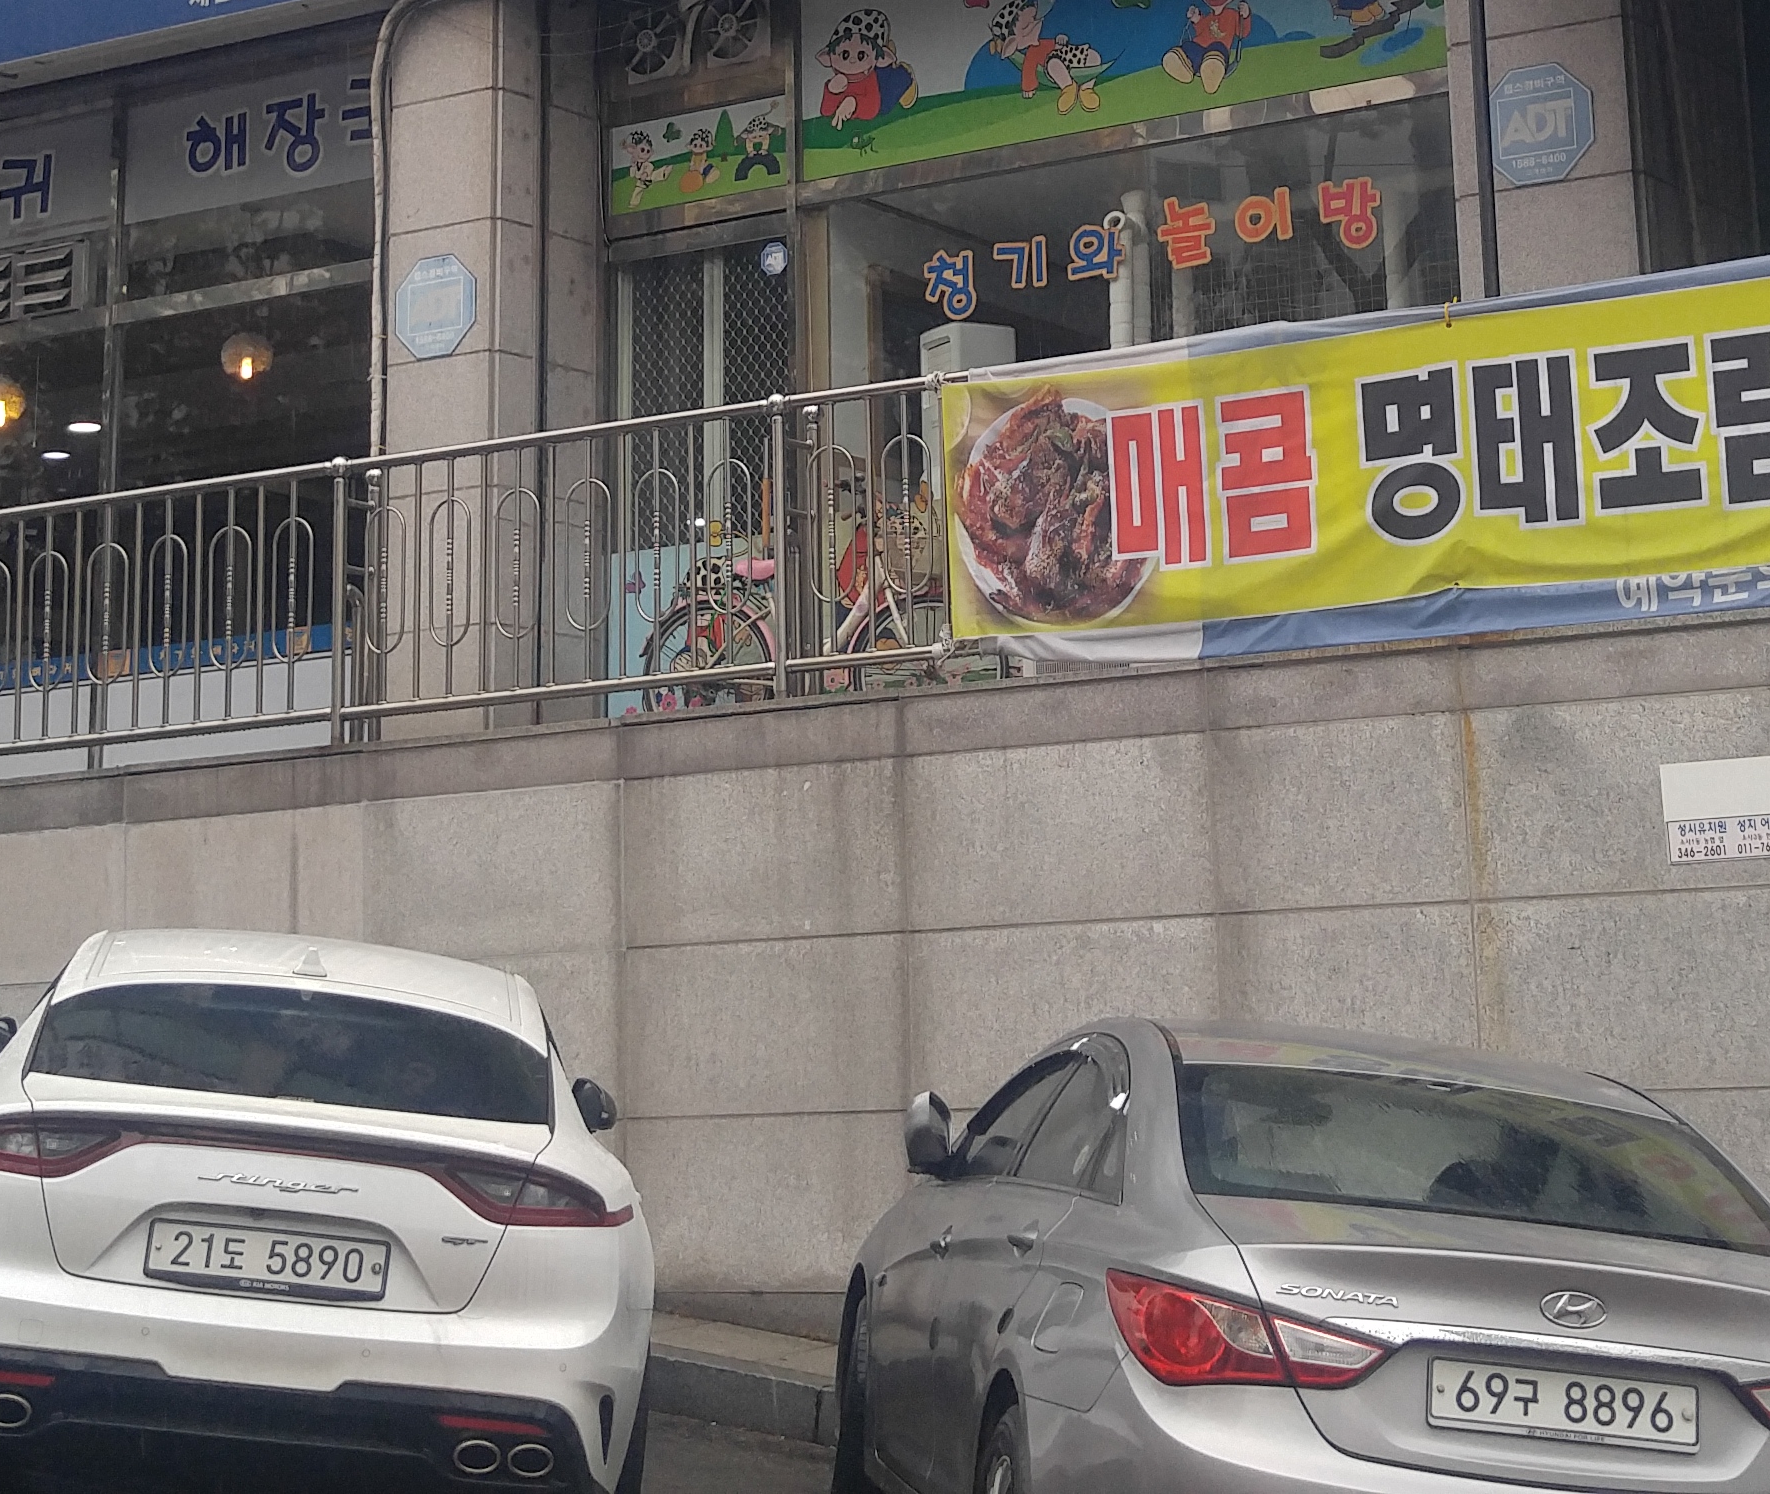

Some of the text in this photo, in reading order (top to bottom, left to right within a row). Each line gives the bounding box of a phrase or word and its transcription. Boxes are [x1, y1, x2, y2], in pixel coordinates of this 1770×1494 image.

[1500, 98, 1574, 148] ADT
[925, 176, 1382, 320] 청기와 놀이방
[1109, 386, 1317, 570] 매콤
[1677, 844, 1727, 859] 346-2601
[265, 1237, 365, 1286] 5890
[1275, 1282, 1400, 1308] SONATA
[1456, 1369, 1675, 1435] 69구 8896
